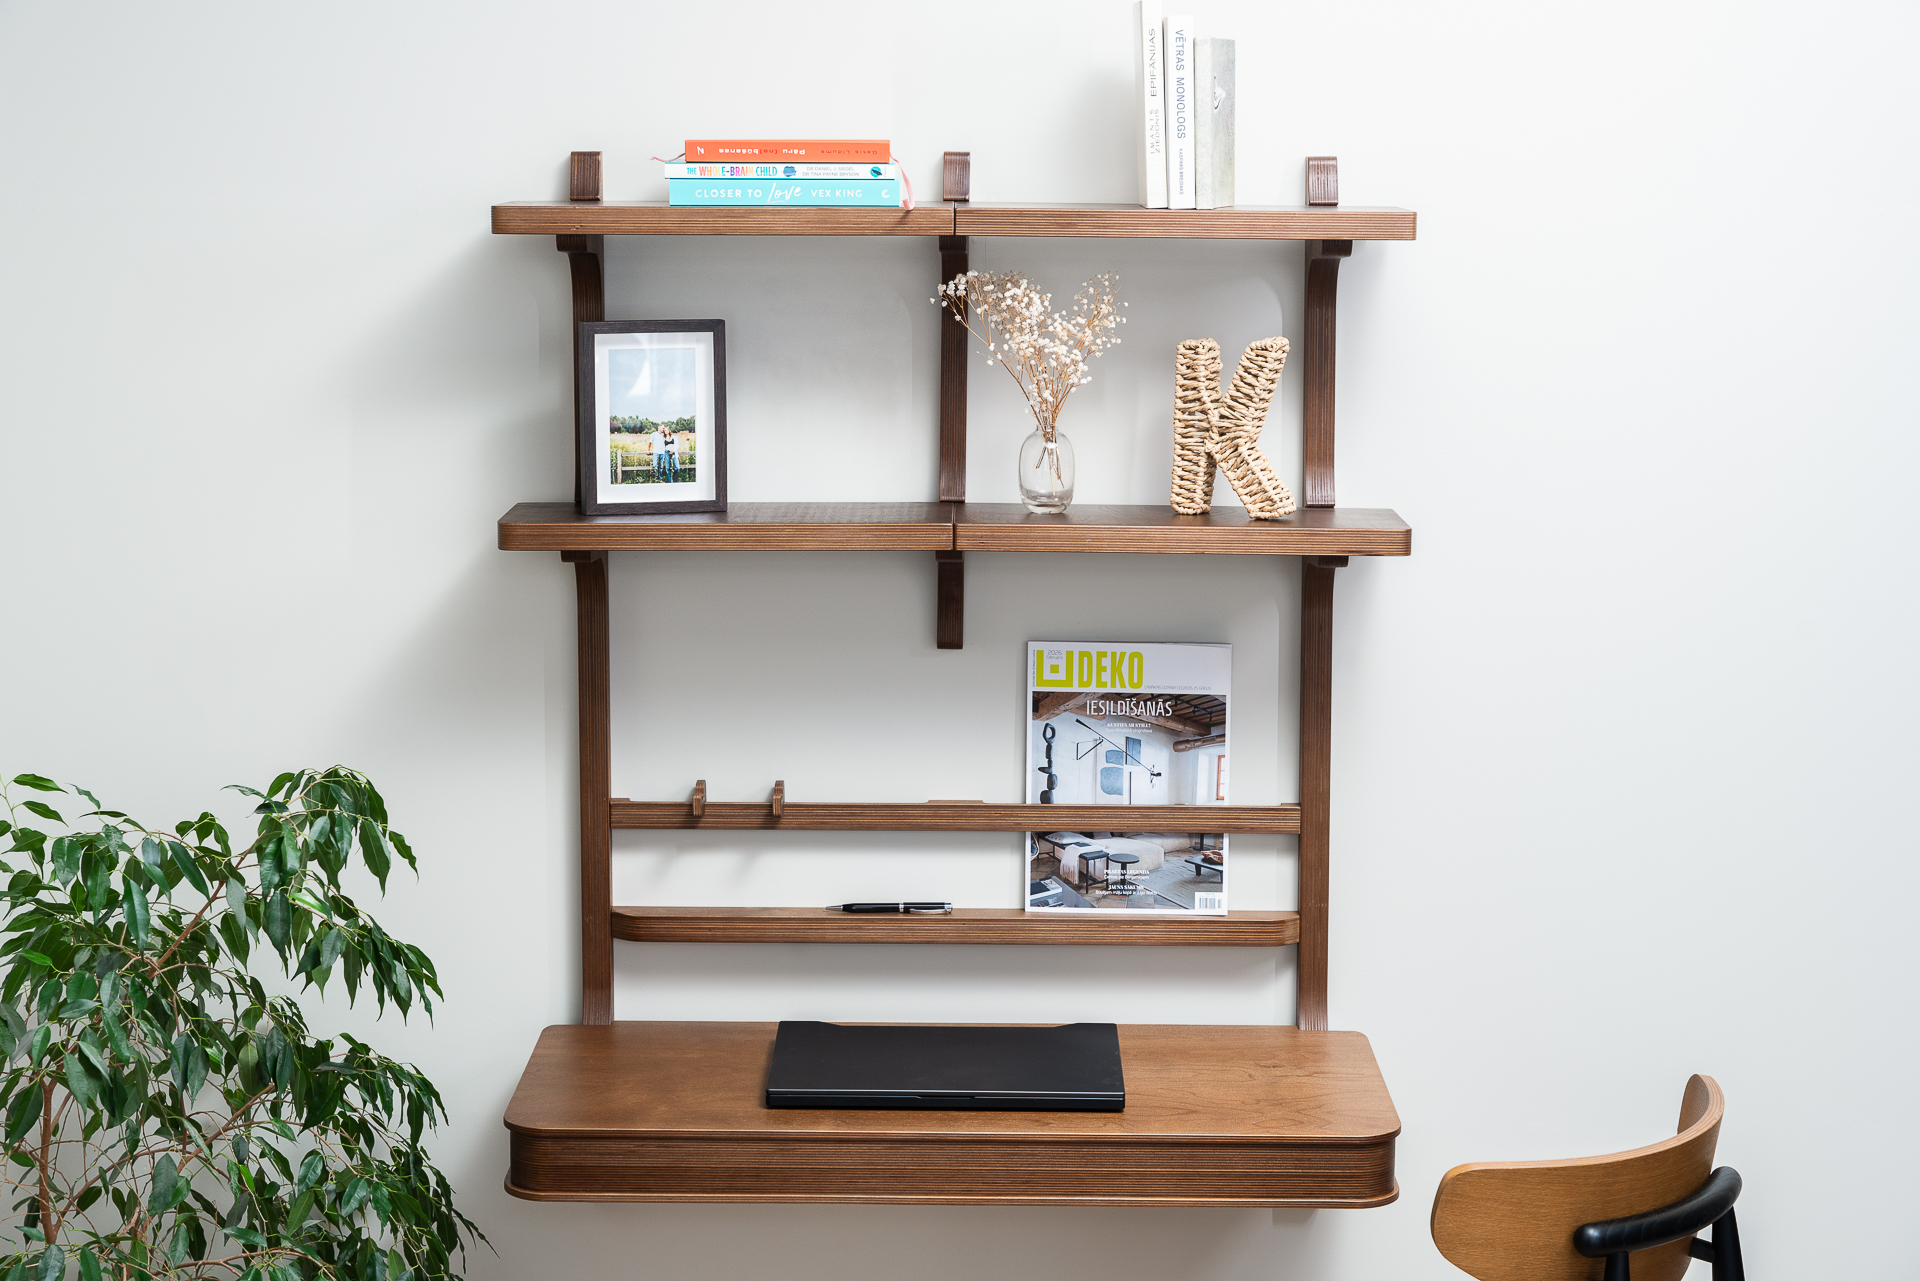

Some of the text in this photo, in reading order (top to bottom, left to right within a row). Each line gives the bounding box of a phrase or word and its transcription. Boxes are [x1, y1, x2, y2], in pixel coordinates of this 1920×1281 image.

[1148, 28, 1157, 97] EPIFĀNIJAS
[1175, 29, 1186, 139] VĒTRAS MONOLOGS
[686, 166, 778, 177] THE WHOLE-BRAIN CHILD
[695, 189, 742, 198] CLOSER
[747, 189, 762, 198] TO
[811, 189, 832, 198] VEX
[835, 189, 863, 198] KING
[1170, 336, 1296, 520] K
[1077, 651, 1143, 689] DEKO
[1086, 698, 1173, 717] IESILDĪŠANĀS
